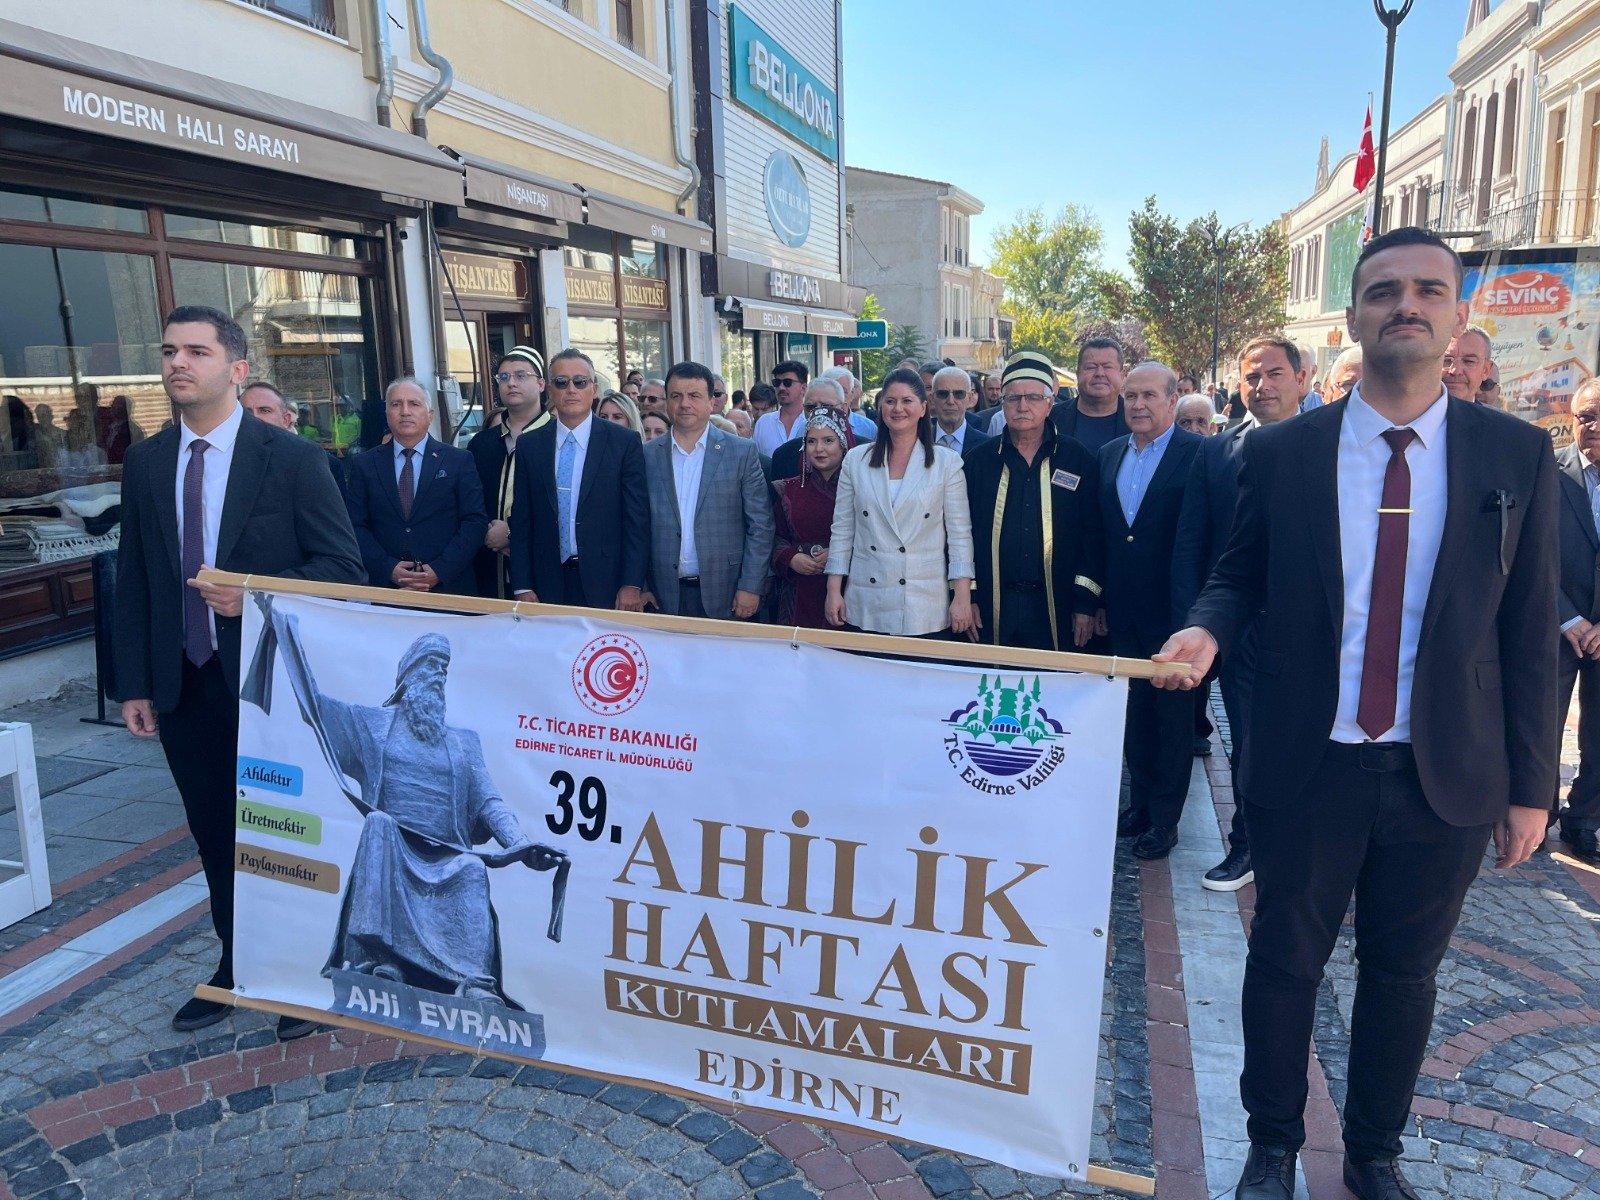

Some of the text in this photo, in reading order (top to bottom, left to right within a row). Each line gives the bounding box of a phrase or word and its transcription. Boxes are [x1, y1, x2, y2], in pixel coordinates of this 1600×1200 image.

[748, 40, 835, 140] BELLONA
[62, 86, 300, 164] MODERN HALI SARAYI
[507, 182, 549, 211] NİŞANTAŞI
[443, 256, 516, 296] NİŞANTAŞI
[565, 272, 612, 304] NİŞANTAŞI
[623, 279, 665, 307] NİŞANTAŞI
[769, 271, 822, 303] BELLONA
[763, 312, 790, 328] BELLONA
[822, 320, 845, 333] BELLONA
[518, 714, 698, 752] T.C. TİCARET BAKANLIĞI
[515, 737, 693, 773] EDİRNE TİCARET İL MÜDÜRLÜĞÜ
[943, 732, 965, 769] T.C.
[960, 765, 1016, 796] Edirne
[241, 766, 292, 788] Ahlaktır
[241, 807, 306, 836] Üretmektir
[545, 770, 622, 844] 39.
[240, 852, 318, 883] Paylaşmaktır
[612, 809, 1049, 948] AHİLİK
[604, 896, 1036, 1032] HAFTASI
[418, 1000, 532, 1048] EVRAN
[614, 977, 1022, 1088] KUTLAMALARI
[694, 1048, 903, 1126] EDİRNE
